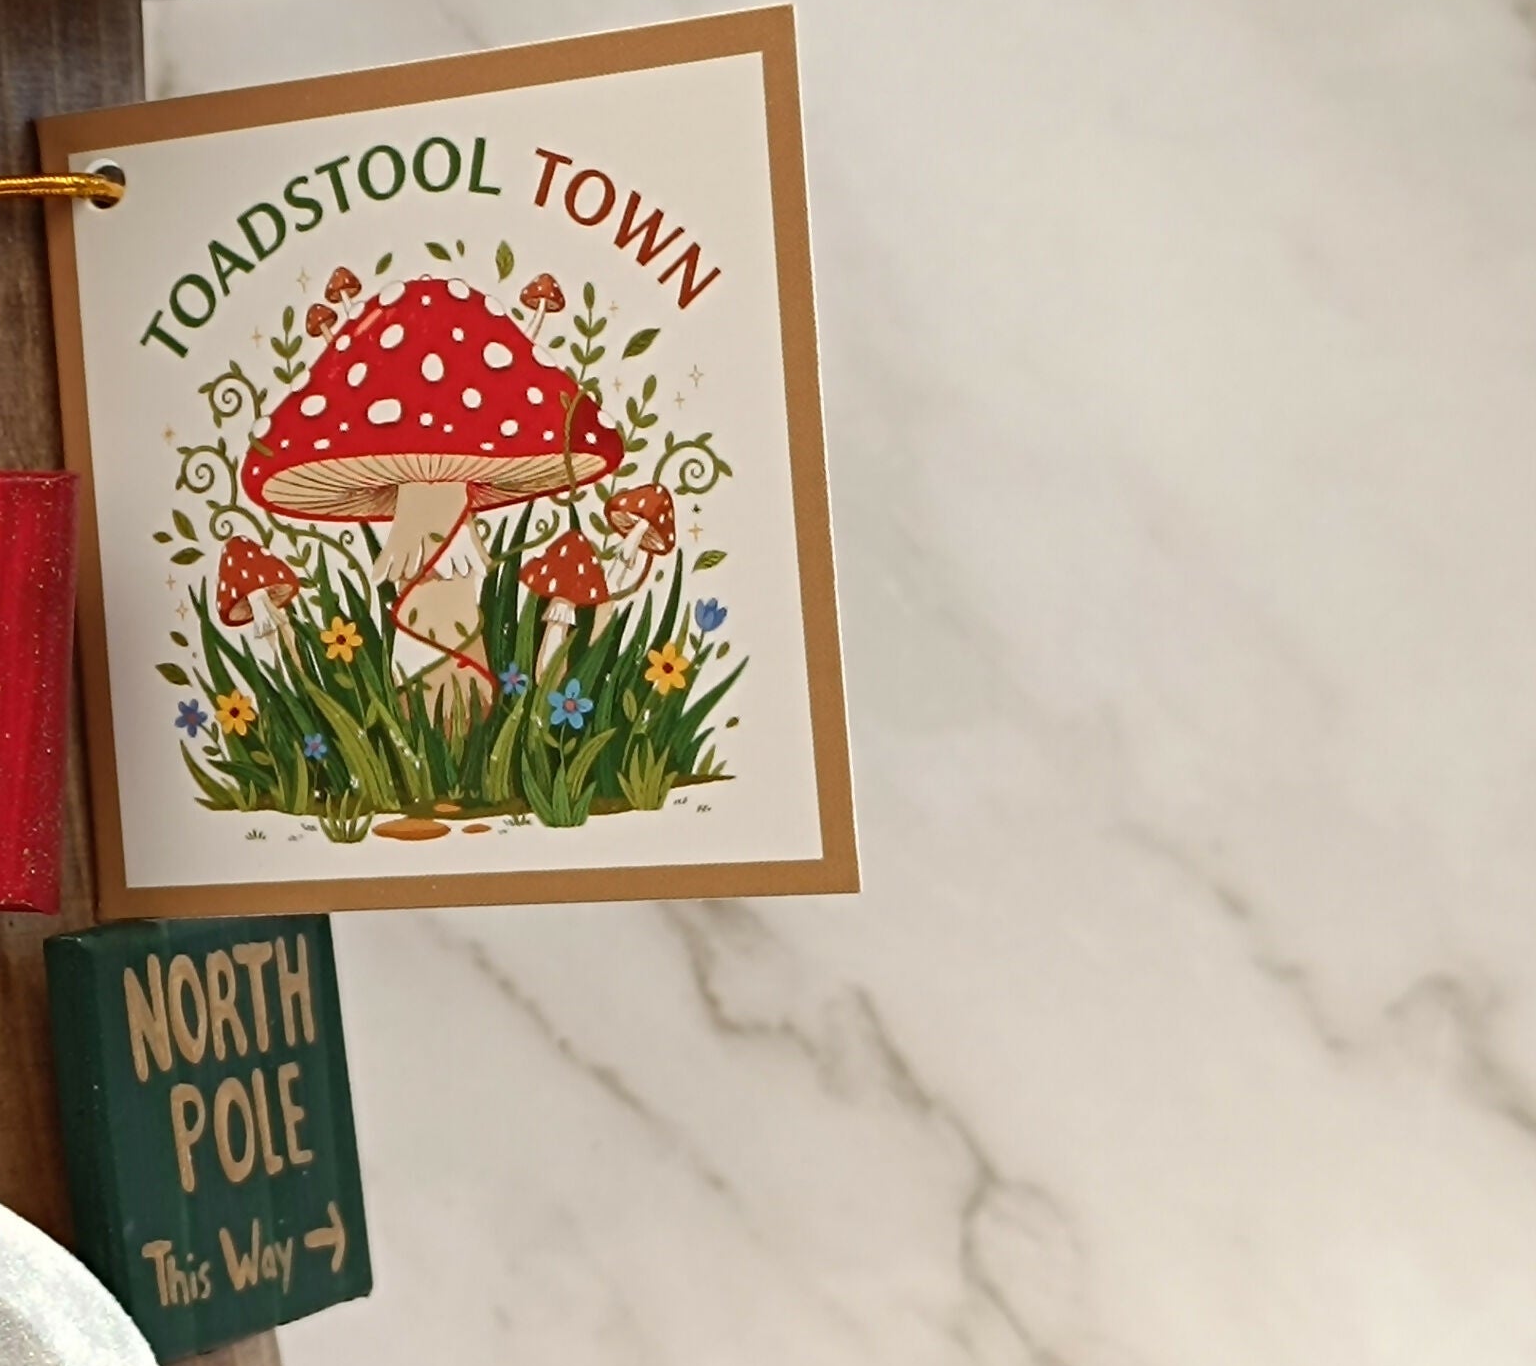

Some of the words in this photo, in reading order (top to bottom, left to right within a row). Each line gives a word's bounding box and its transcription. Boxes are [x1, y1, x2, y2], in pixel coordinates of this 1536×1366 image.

[140, 136, 502, 361] TOADSTOOL
[529, 146, 722, 311] TOWN
[122, 933, 315, 1083] NORTH
[169, 1061, 314, 1193] POLE
[141, 1239, 212, 1307] This
[218, 1217, 294, 1294] Way
